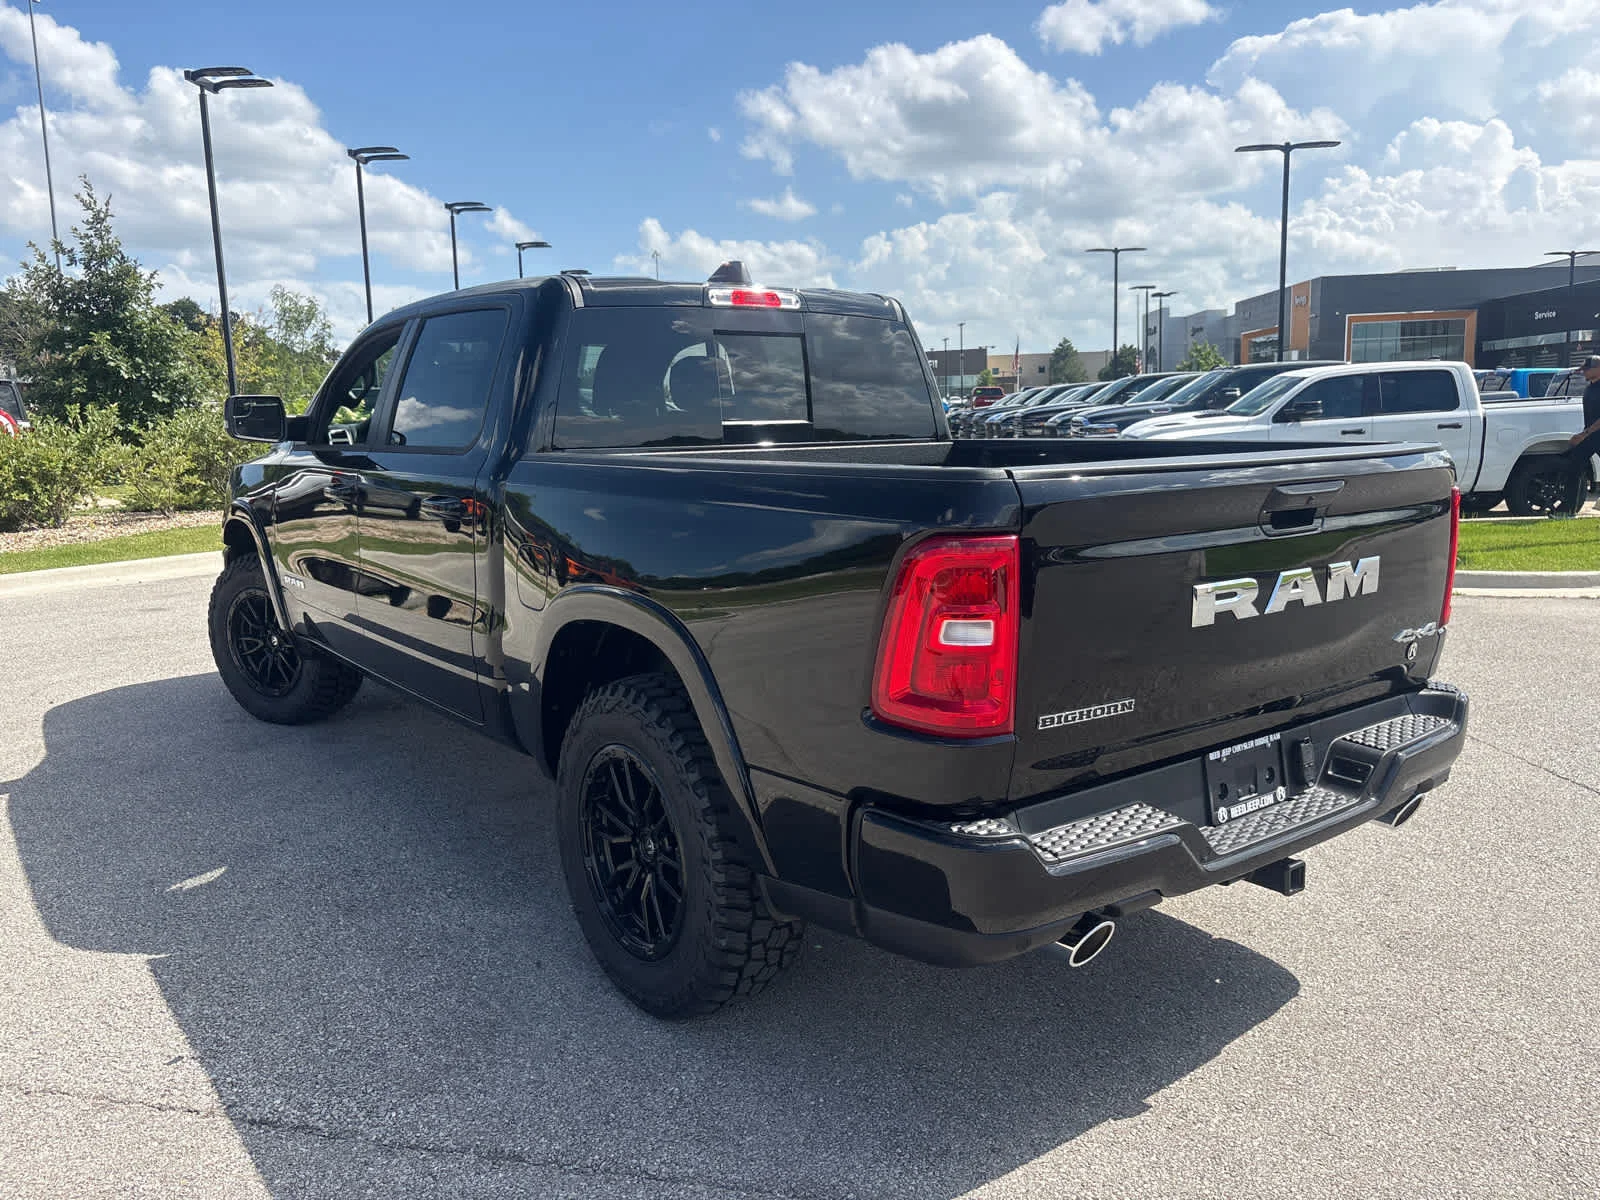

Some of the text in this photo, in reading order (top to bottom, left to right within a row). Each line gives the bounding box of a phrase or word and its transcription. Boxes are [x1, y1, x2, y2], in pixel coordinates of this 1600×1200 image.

[1534, 311, 1557, 320] Service
[1191, 555, 1381, 628] RAM
[1038, 699, 1135, 730] BIGHORN
[1221, 746, 1232, 757] JEEP
[1232, 740, 1254, 753] CHRYSLER
[1269, 732, 1280, 742] RAM
